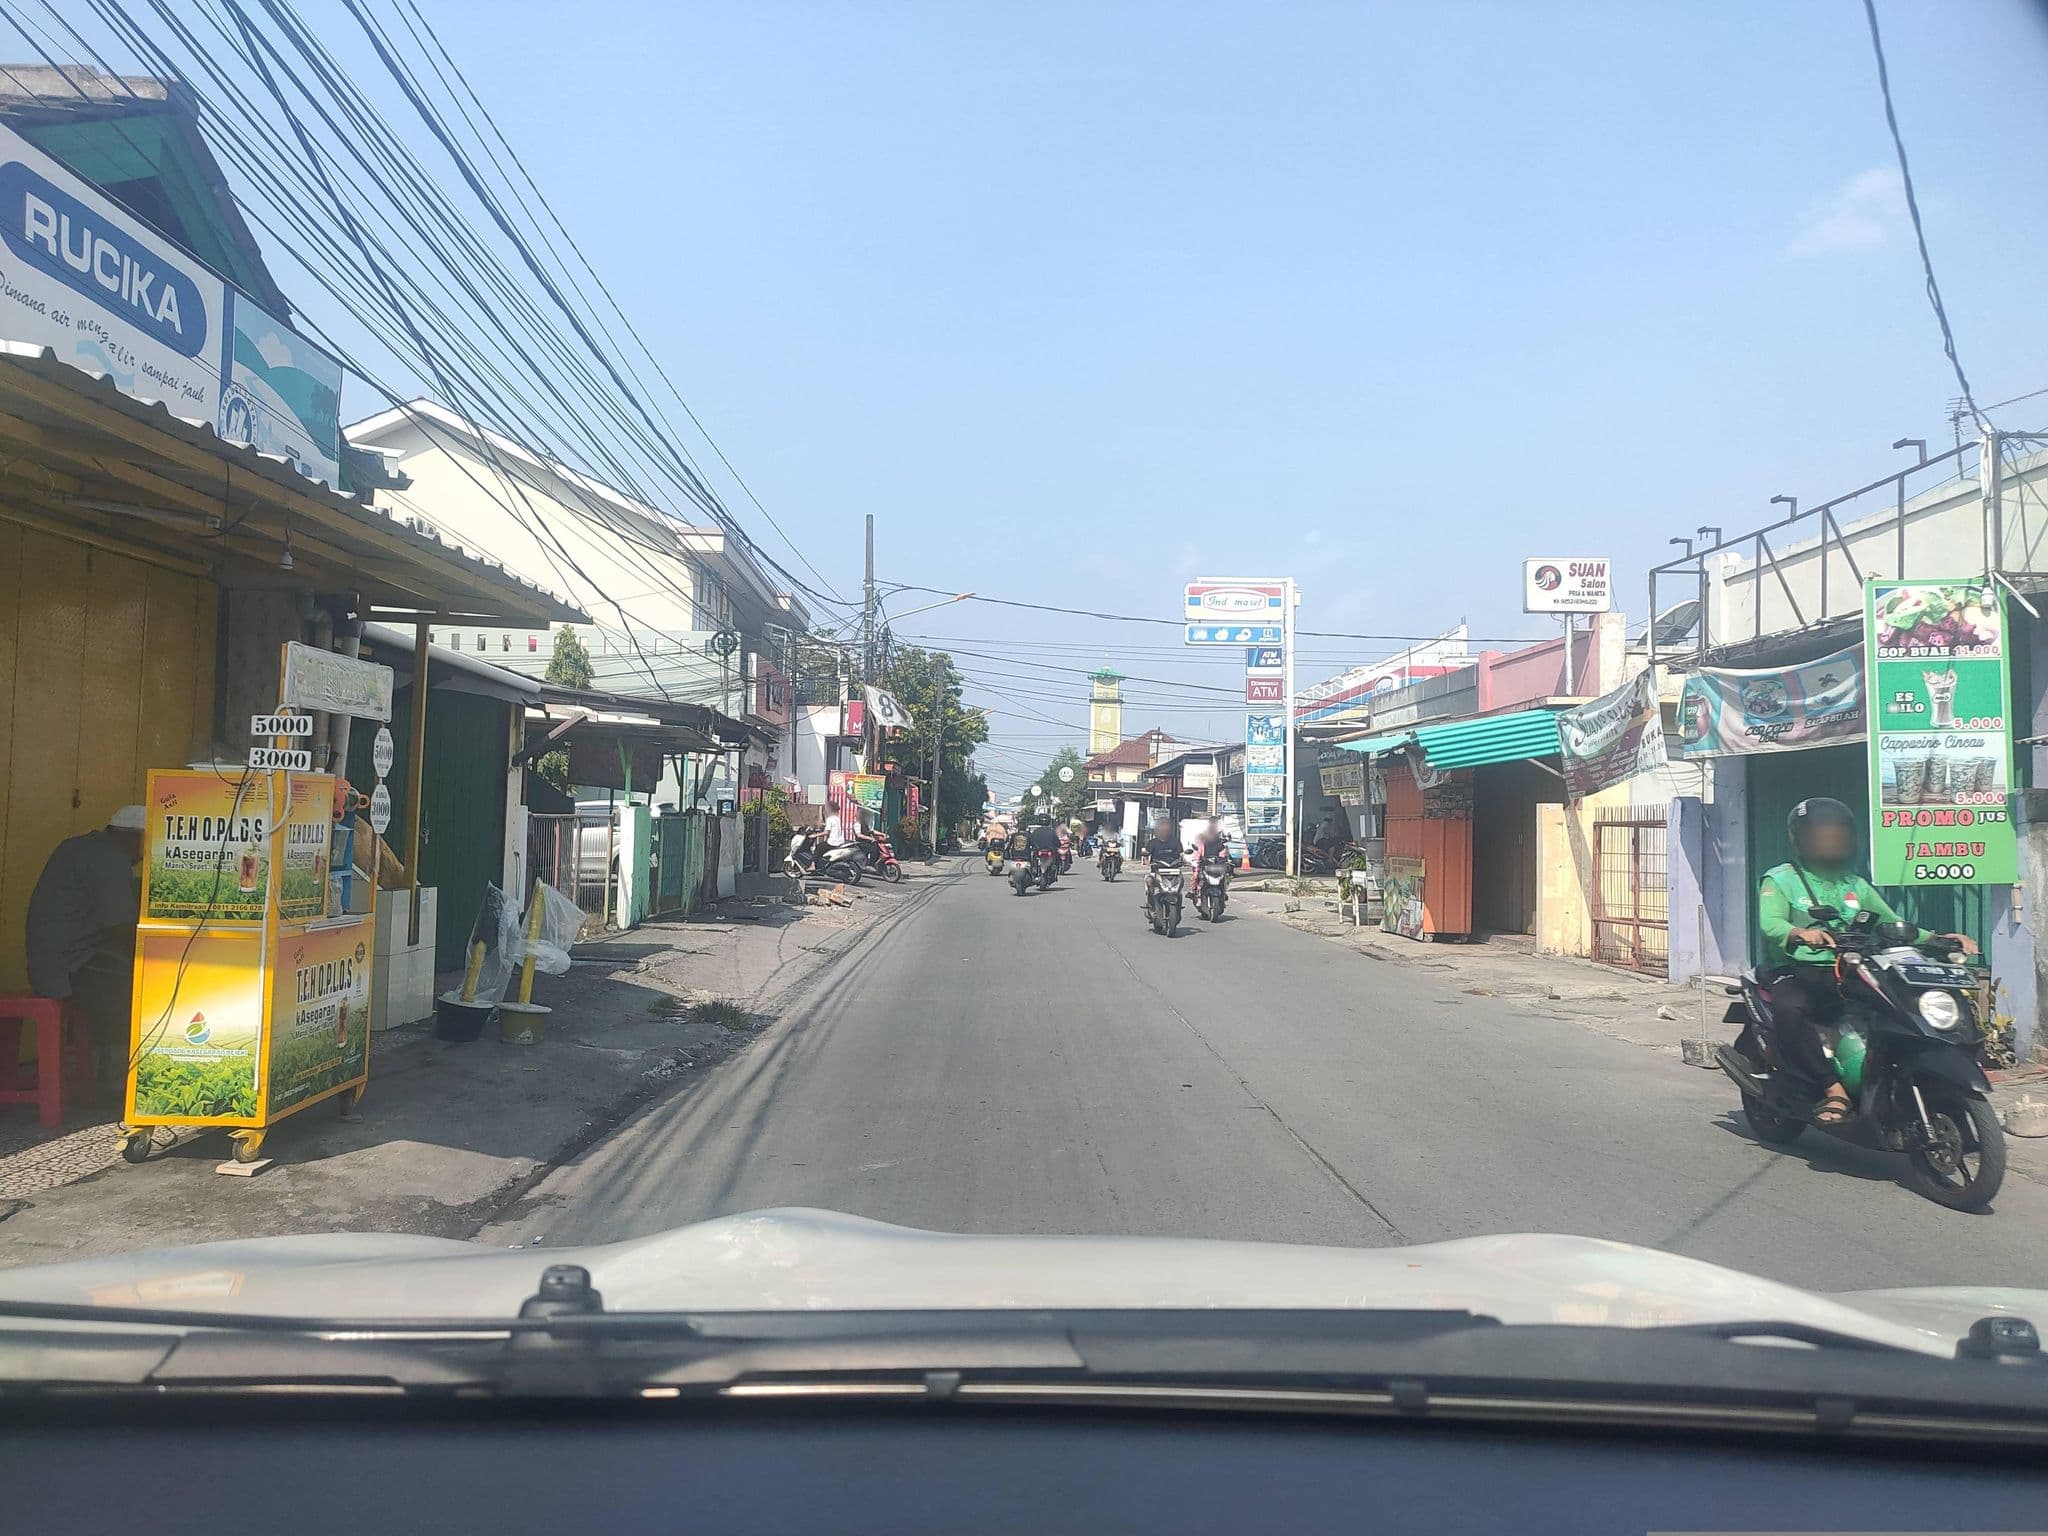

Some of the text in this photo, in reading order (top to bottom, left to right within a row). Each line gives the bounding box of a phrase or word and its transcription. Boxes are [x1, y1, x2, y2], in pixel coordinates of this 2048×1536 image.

[25, 192, 183, 336] RUCIKA
[51, 305, 71, 328] air
[77, 318, 136, 367] mengalir
[142, 360, 180, 390] sampai
[180, 380, 204, 404] jauh
[1568, 562, 1606, 577] SUAN
[1580, 578, 1606, 589] Salon
[1878, 647, 1907, 657] SOP
[1910, 646, 1950, 657] BUAH
[1252, 686, 1278, 698] ATM
[1894, 691, 1915, 702] ES
[254, 717, 309, 734] 5000
[1953, 716, 2003, 728] 5.000
[1641, 726, 1663, 749] BUKA
[1880, 735, 1985, 752] Cappucino Cincau
[252, 749, 307, 769] 3000
[374, 745, 393, 760] 5000
[1954, 791, 2006, 805] 5.000
[371, 801, 390, 817] 3000
[1881, 808, 2007, 827] PROMO JUS
[165, 846, 234, 863] kAsegaran
[1905, 842, 1985, 860] JAMBU
[1914, 864, 1975, 880] 5.000
[295, 1003, 336, 1027] kAsegaran
